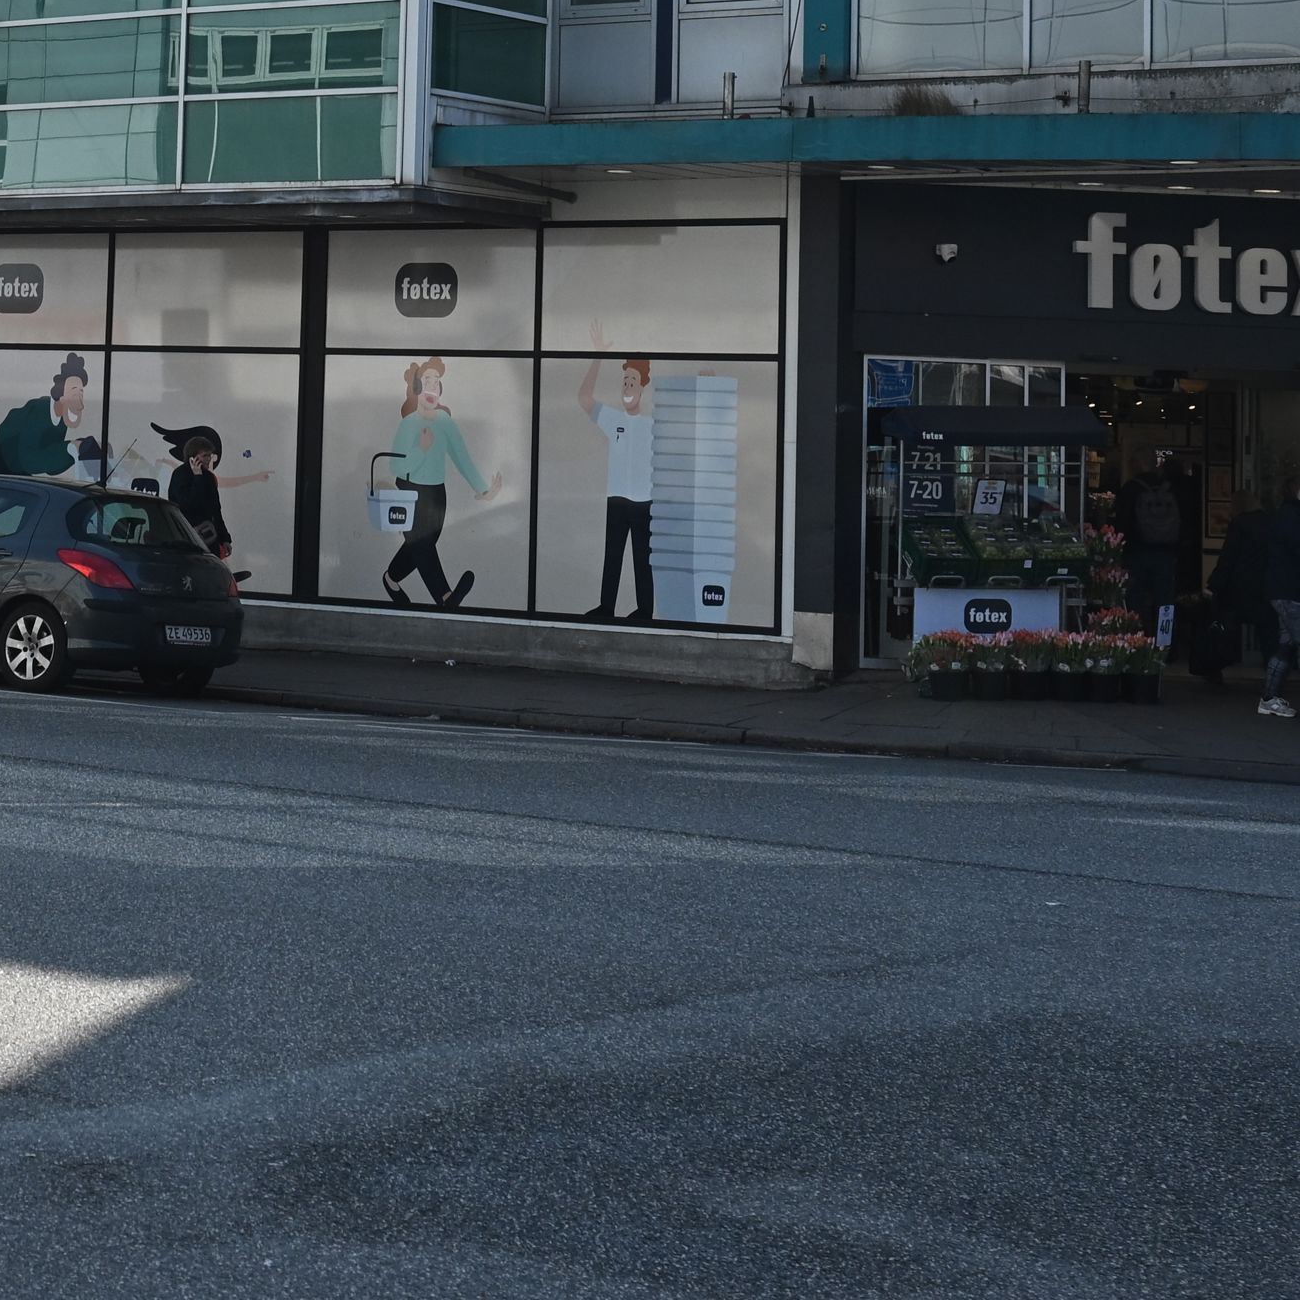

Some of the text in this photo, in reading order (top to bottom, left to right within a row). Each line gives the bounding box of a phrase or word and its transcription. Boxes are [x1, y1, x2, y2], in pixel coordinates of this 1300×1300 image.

[1072, 211, 1300, 317] føte
[401, 276, 452, 300] føtex
[911, 451, 941, 470] 721
[908, 480, 942, 499] 7-20
[969, 607, 1008, 623] føtex
